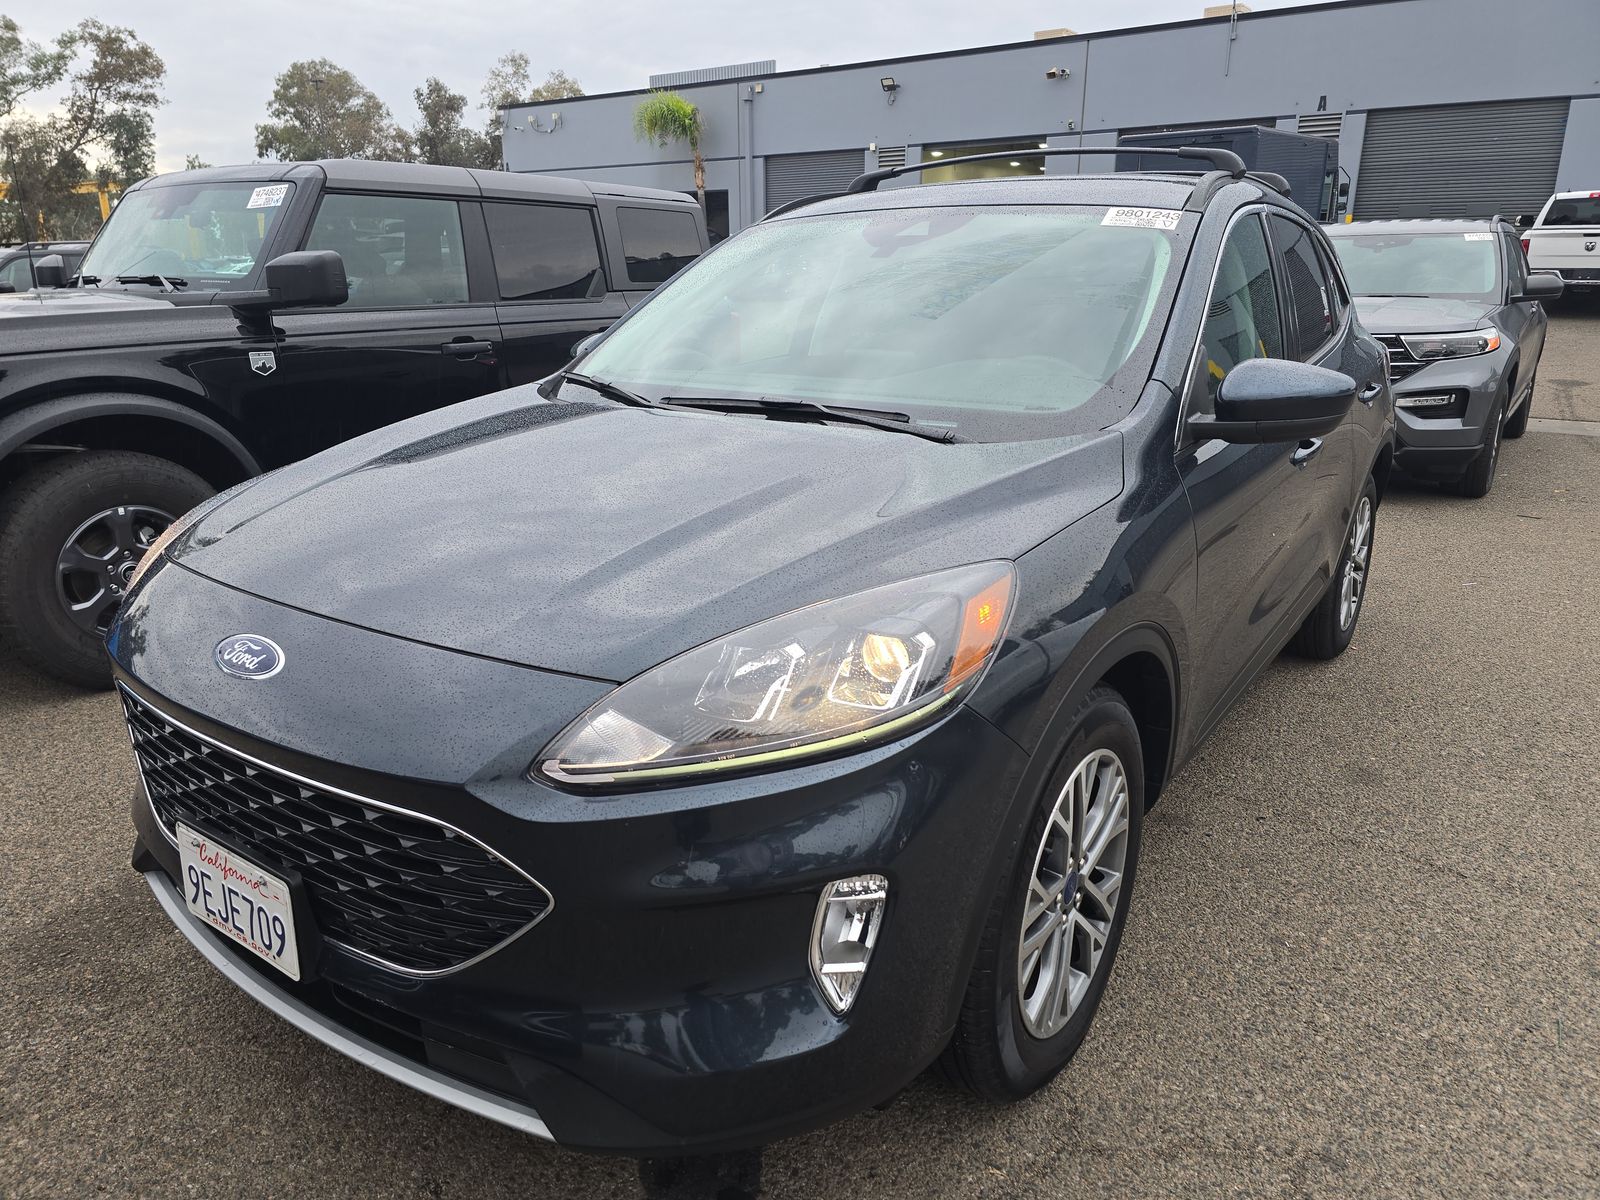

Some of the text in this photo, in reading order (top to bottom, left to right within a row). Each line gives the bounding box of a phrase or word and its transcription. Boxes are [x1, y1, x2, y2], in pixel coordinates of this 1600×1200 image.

[1317, 95, 1327, 112] A
[1115, 208, 1181, 221] 9801243
[224, 640, 267, 670] Ford
[199, 843, 269, 899] California
[188, 864, 287, 958] 9EJE709
[211, 917, 270, 958] dmv.ca.gov
